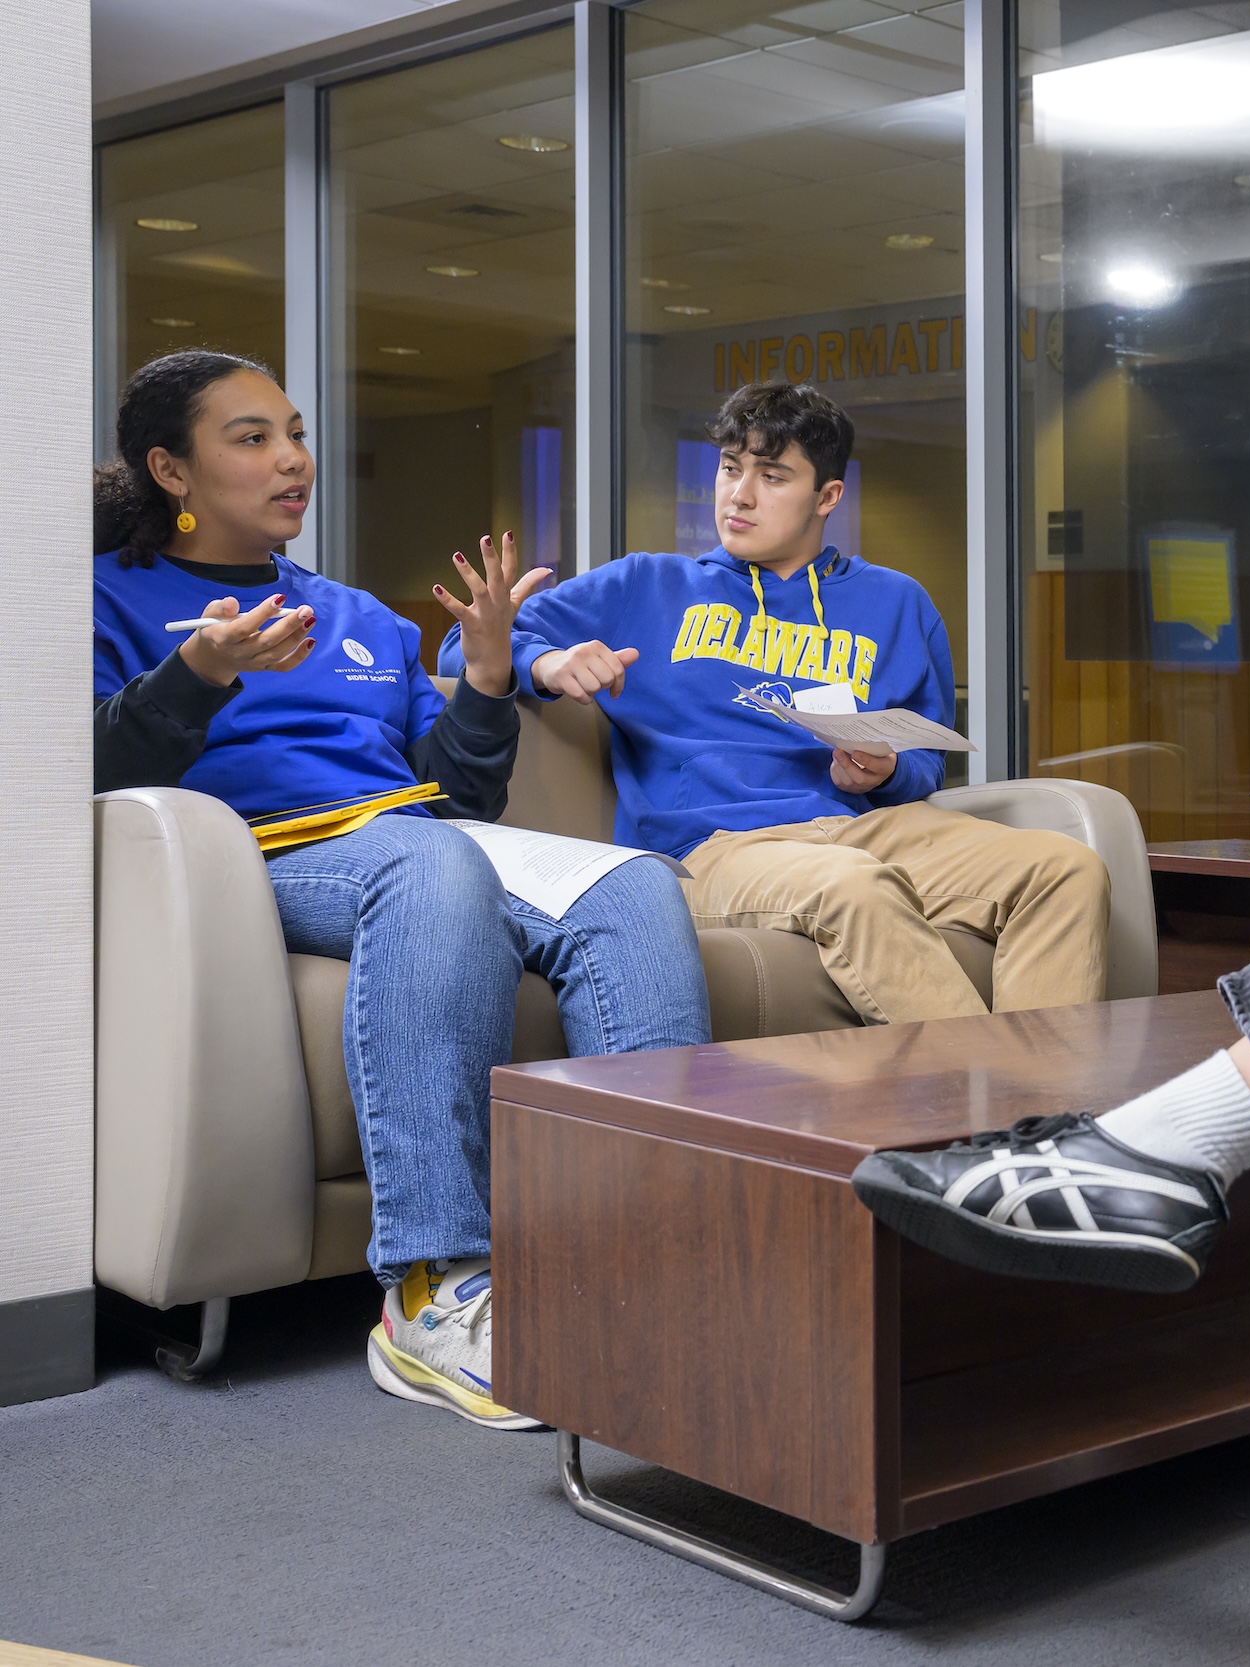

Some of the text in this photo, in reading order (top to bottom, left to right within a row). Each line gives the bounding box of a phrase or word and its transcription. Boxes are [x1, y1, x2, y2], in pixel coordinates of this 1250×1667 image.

[714, 308, 1037, 393] INFORMATIN
[671, 603, 878, 704] DELAWARE
[345, 674, 398, 684] BIDEN SCHOOL
[808, 702, 833, 712] Alex
